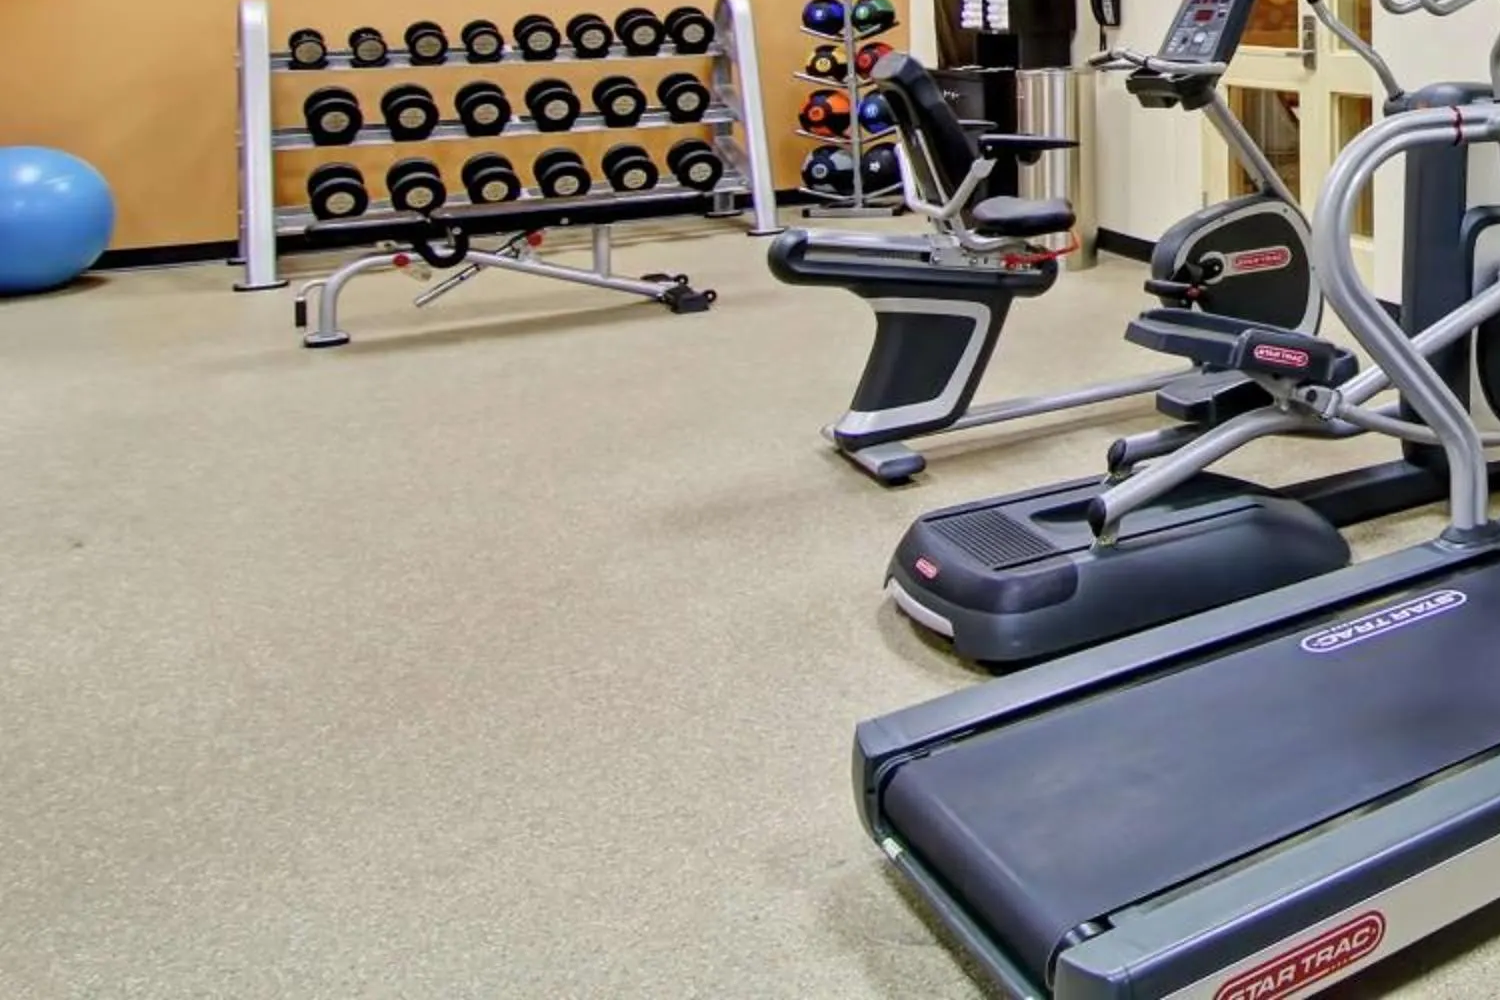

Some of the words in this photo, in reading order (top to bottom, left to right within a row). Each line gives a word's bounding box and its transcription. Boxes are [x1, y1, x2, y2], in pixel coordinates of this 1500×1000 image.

[1391, 592, 1455, 619] STAR
[1317, 617, 1392, 647] TRAC
[1300, 926, 1371, 973] TRAC
